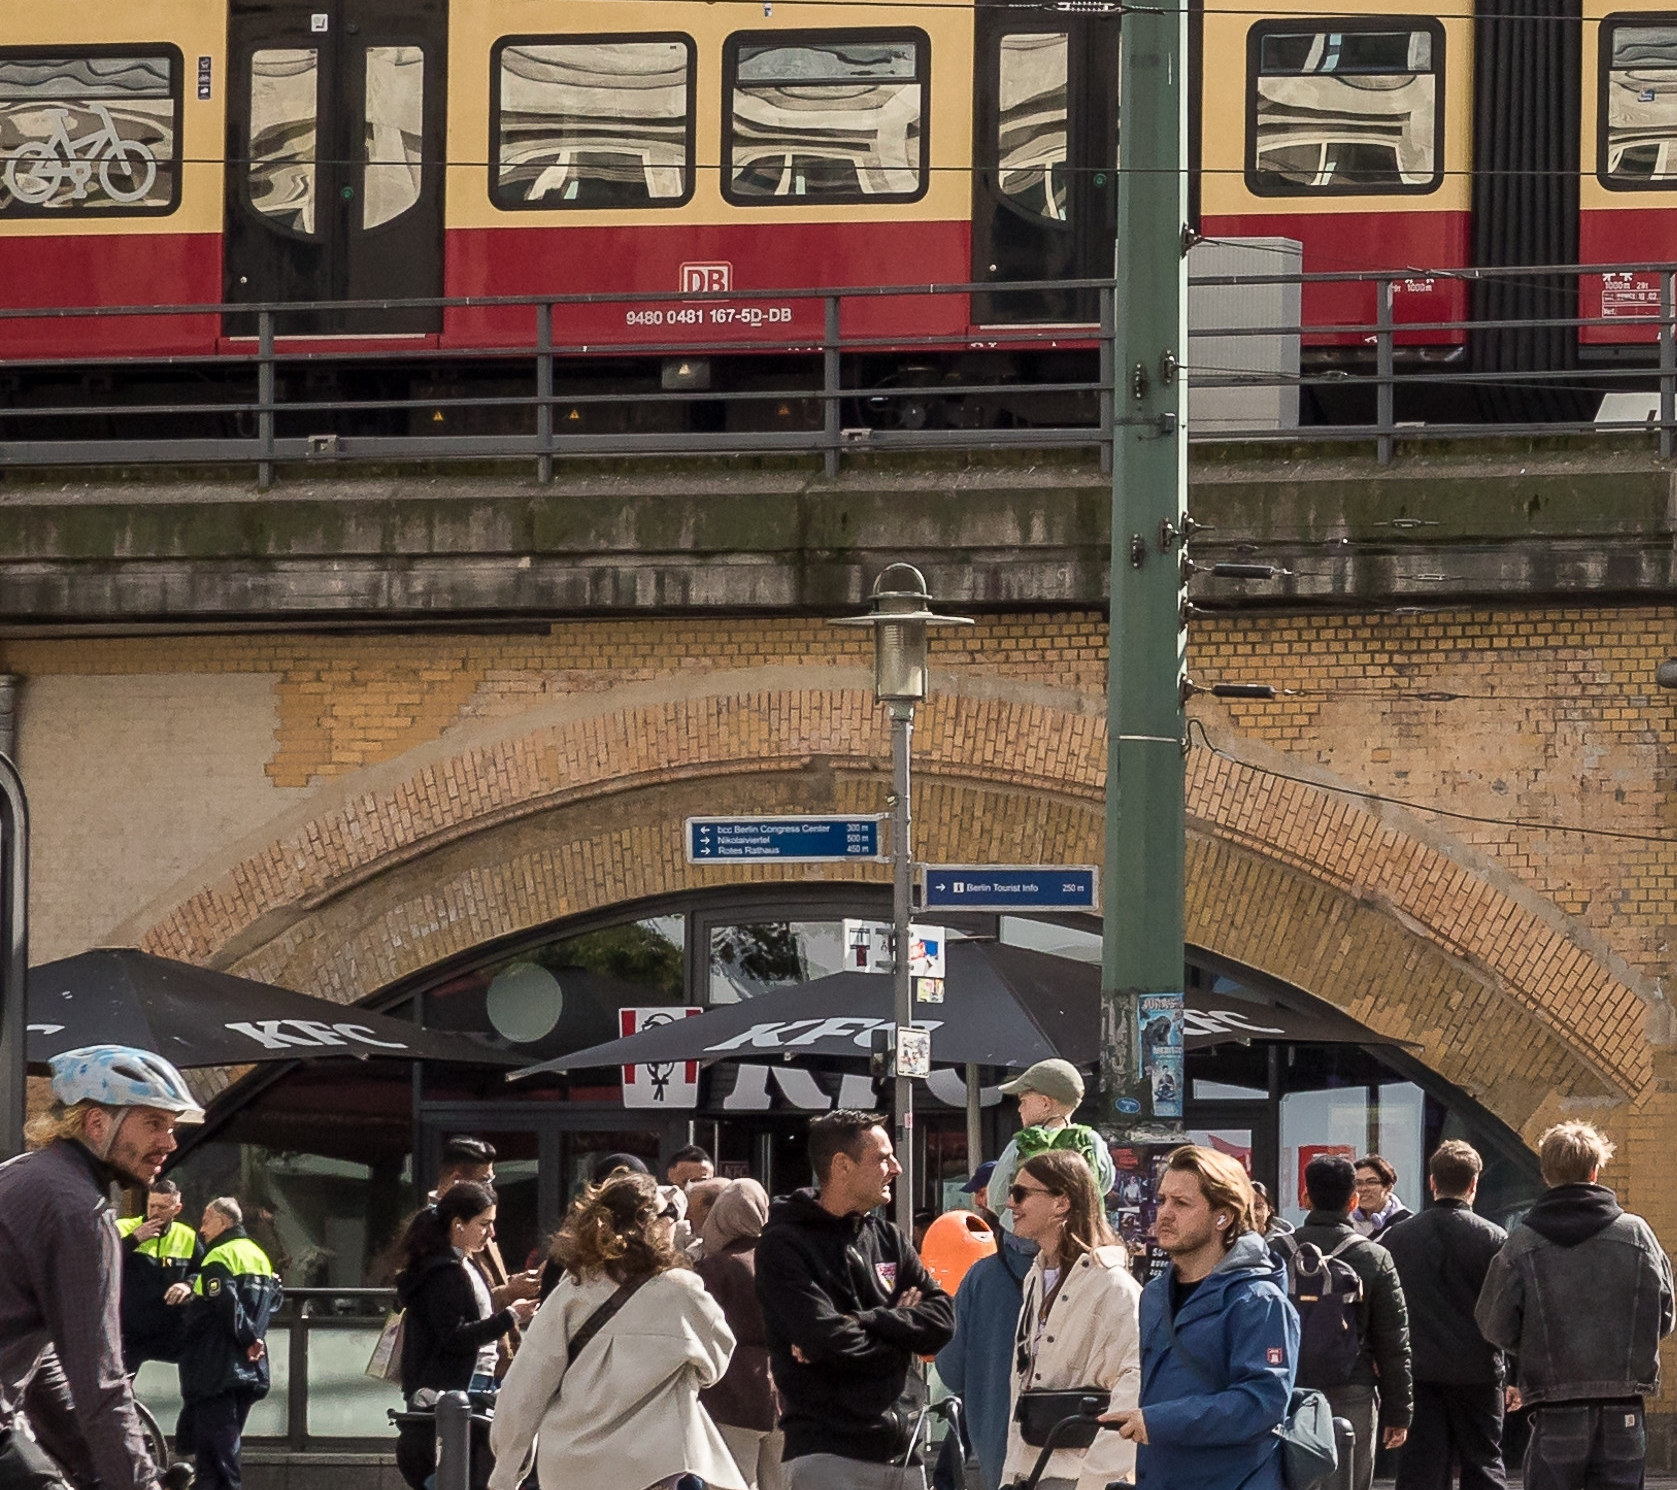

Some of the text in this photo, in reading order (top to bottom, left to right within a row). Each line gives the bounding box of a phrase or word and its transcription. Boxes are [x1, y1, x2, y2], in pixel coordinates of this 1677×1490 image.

[626, 307, 792, 328] 9480 0481 167-5D-DB
[716, 824, 733, 833] bcc
[734, 824, 760, 834] Berlin
[760, 824, 801, 836] Congress
[802, 823, 831, 834] Center
[861, 824, 869, 832] m
[717, 833, 869, 846] Nikolaiviertel 500 m
[718, 844, 869, 856] Rotes Rathaus 450 m
[966, 883, 1085, 893] Berlin Tourist Info 250 m
[1183, 1008, 1286, 1035] FC
[224, 1018, 409, 1050] KFC
[703, 1016, 945, 1052] KFC
